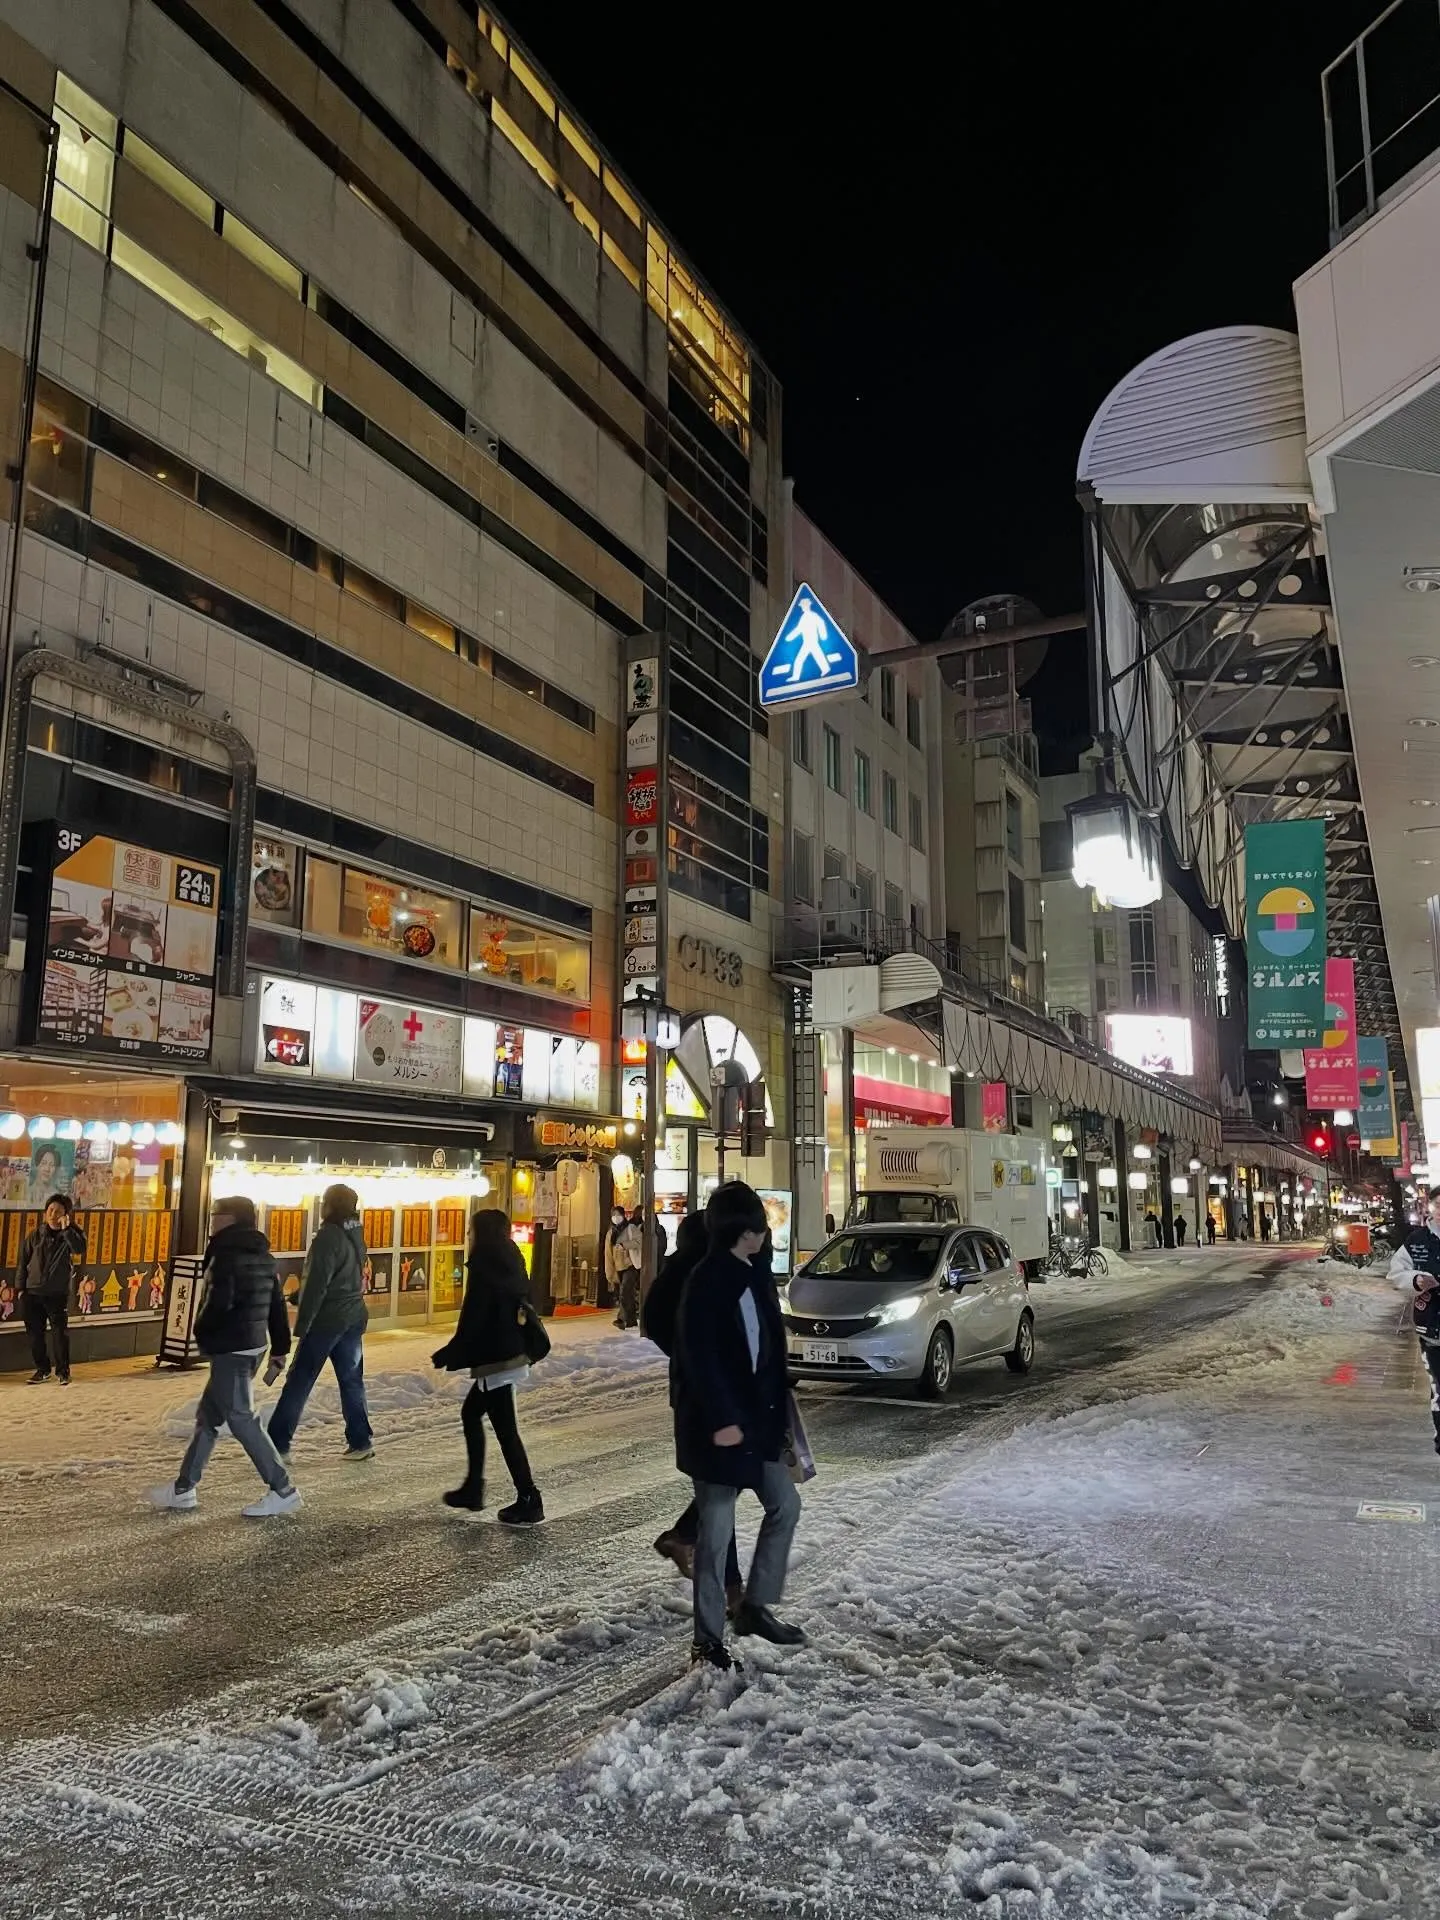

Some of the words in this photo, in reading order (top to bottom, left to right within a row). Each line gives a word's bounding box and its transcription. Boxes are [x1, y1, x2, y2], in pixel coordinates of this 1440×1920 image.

[629, 735, 656, 746] QUEEN
[58, 830, 81, 850] 3F
[180, 869, 211, 895] 24h
[52, 949, 103, 964] インターネット
[176, 971, 200, 982] シャワー
[57, 1032, 86, 1043] コミック
[162, 1045, 205, 1058] フリードリンク
[393, 1066, 428, 1079] メルシー
[810, 1350, 836, 1362] 51-68
